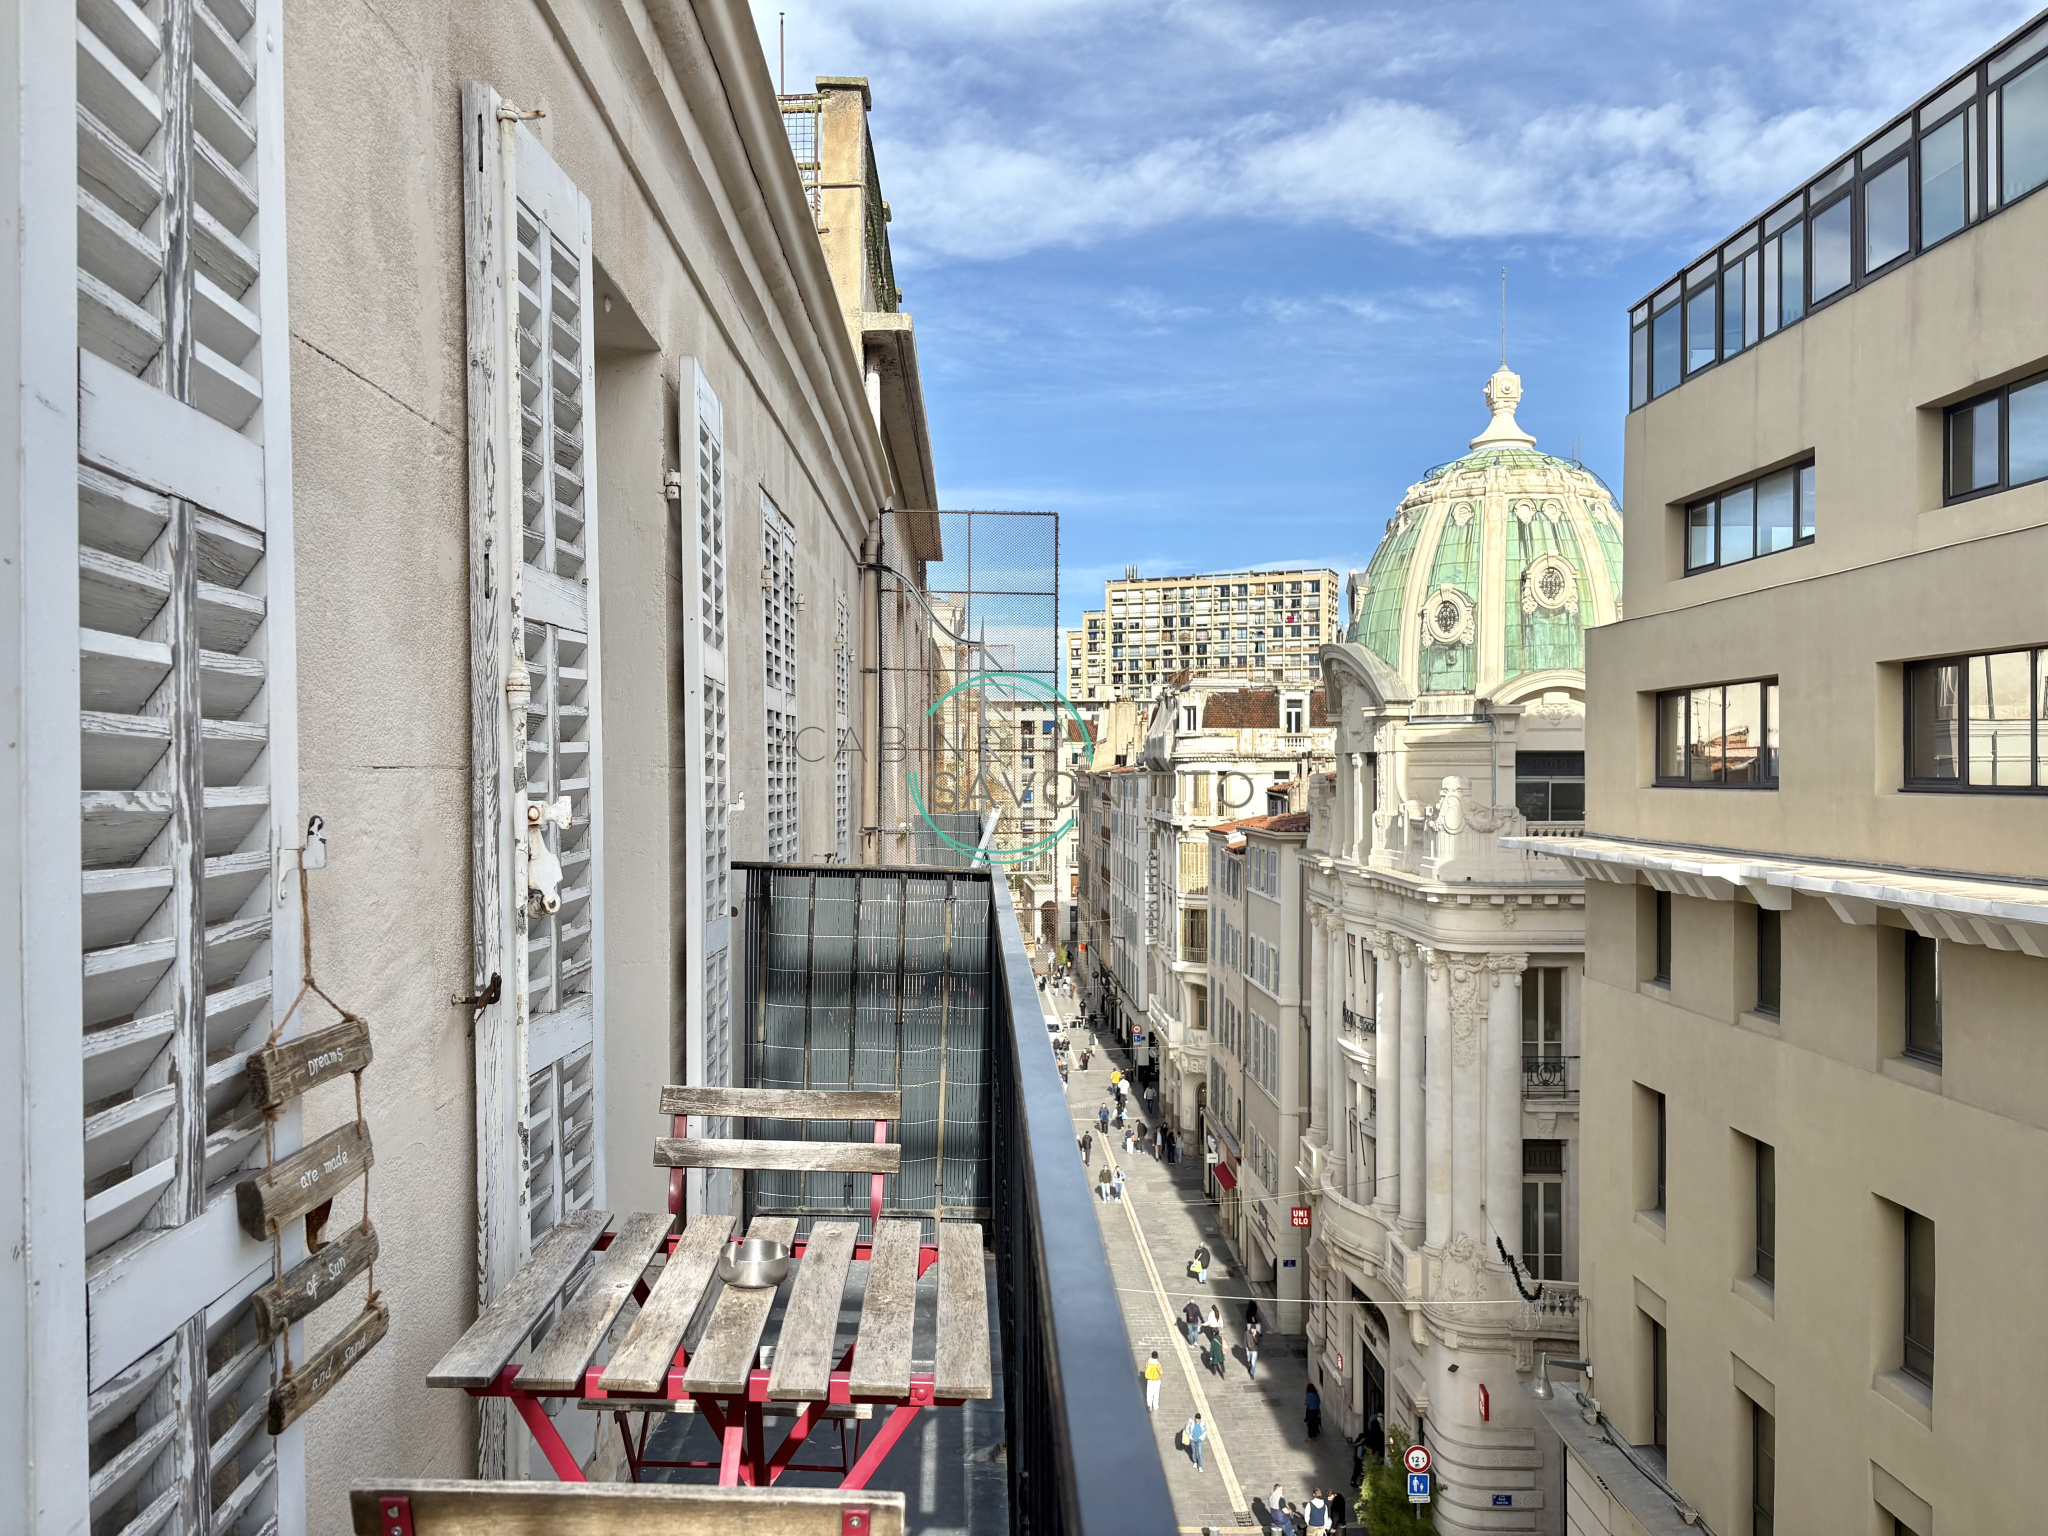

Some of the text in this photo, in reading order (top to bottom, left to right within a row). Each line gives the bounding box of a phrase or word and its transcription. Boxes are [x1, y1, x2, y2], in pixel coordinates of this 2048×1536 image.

[308, 1047, 344, 1077] Dreams
[301, 1144, 348, 1188] are made
[1293, 1209, 1307, 1217] UNI
[1293, 1217, 1308, 1226] QLO
[307, 1274, 318, 1300] of
[312, 1355, 334, 1391] and
